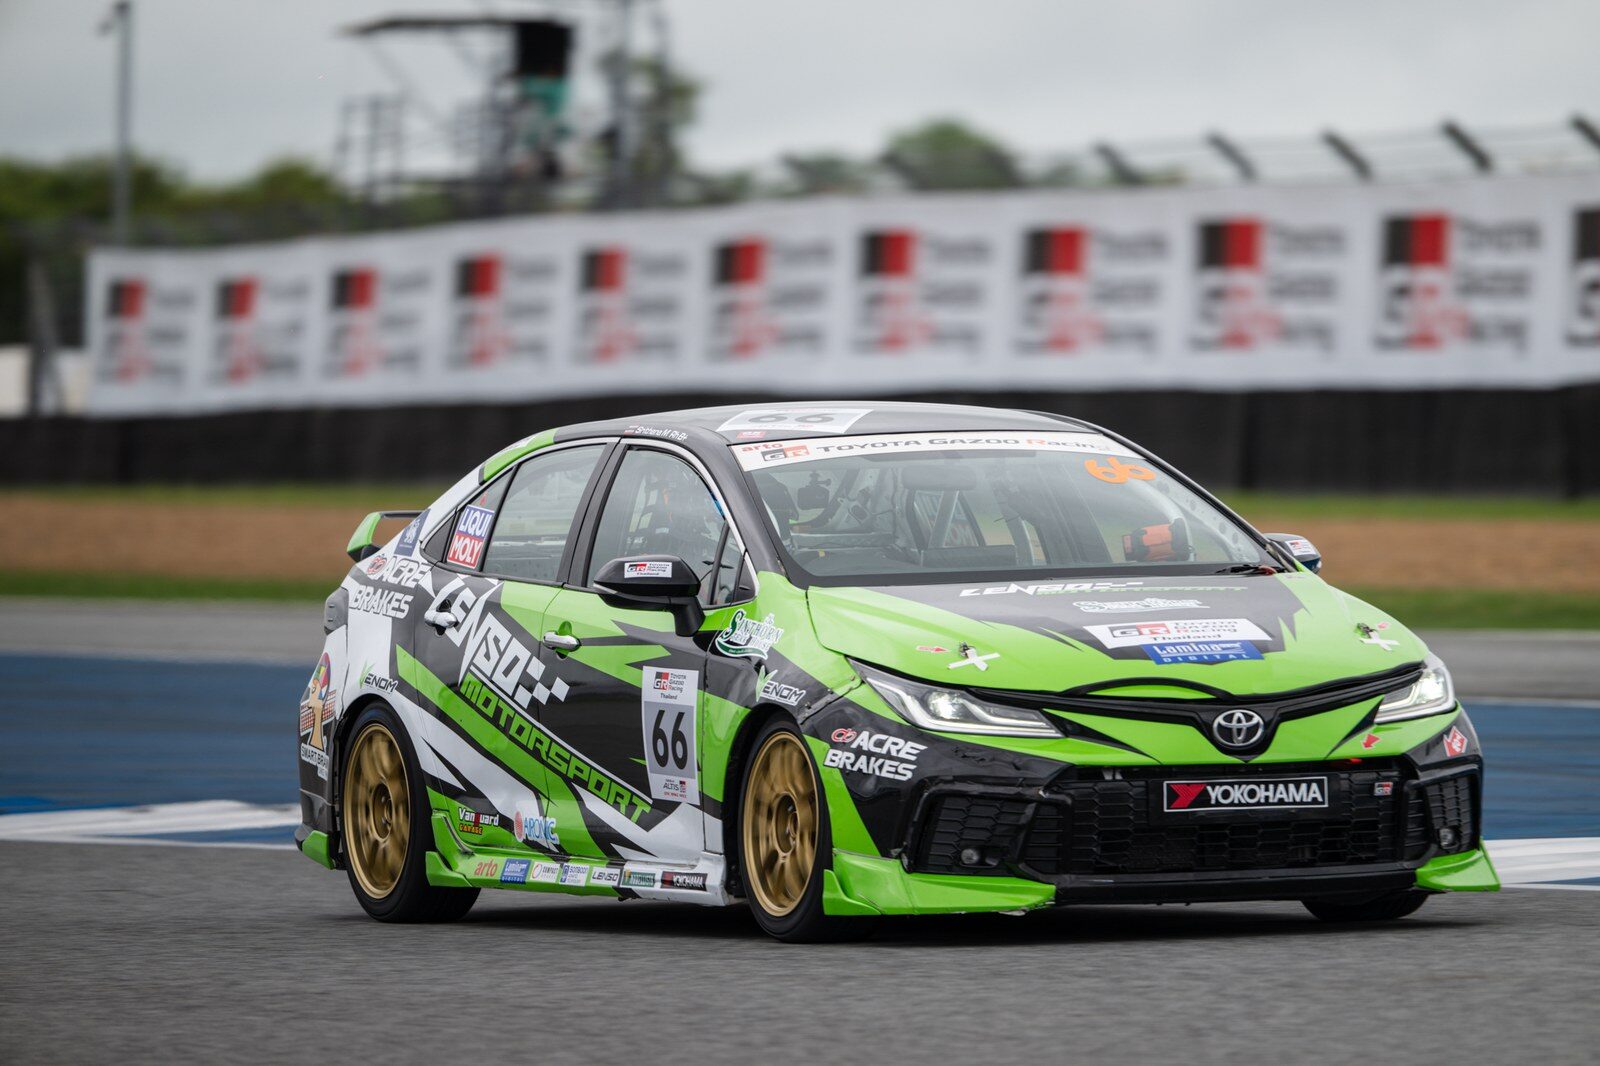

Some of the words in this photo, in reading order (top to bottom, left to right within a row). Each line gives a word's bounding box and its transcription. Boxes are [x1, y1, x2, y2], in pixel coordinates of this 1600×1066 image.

[747, 412, 837, 423] 66
[741, 442, 784, 453] arto
[763, 448, 810, 462] GR
[816, 439, 921, 456] TOYOTA
[928, 437, 1020, 449] GAZOO
[1025, 439, 1112, 452] Racin
[1084, 455, 1157, 484] 66
[459, 509, 494, 539] LIQUI
[449, 540, 484, 568] MOLY
[379, 556, 432, 588] ACRE
[960, 582, 1094, 597] LENSO
[350, 585, 415, 619] BRAKES
[425, 576, 532, 700] LENSO
[1152, 633, 1222, 641] Thailand
[1163, 654, 1251, 663] DIGITAL
[654, 679, 669, 690] GR
[756, 665, 806, 703] VENOM
[660, 692, 678, 700] Thailand
[459, 671, 652, 824] MOTORSPORT
[652, 709, 688, 771] 66
[850, 730, 929, 761] ACRE
[823, 748, 918, 781] BRAKES
[663, 782, 680, 792] ALTIS
[1206, 782, 1325, 805] YOKOHAMA
[474, 859, 499, 878] arto
[592, 871, 619, 883] LENSO
[672, 873, 704, 889] YOKOHAMA
